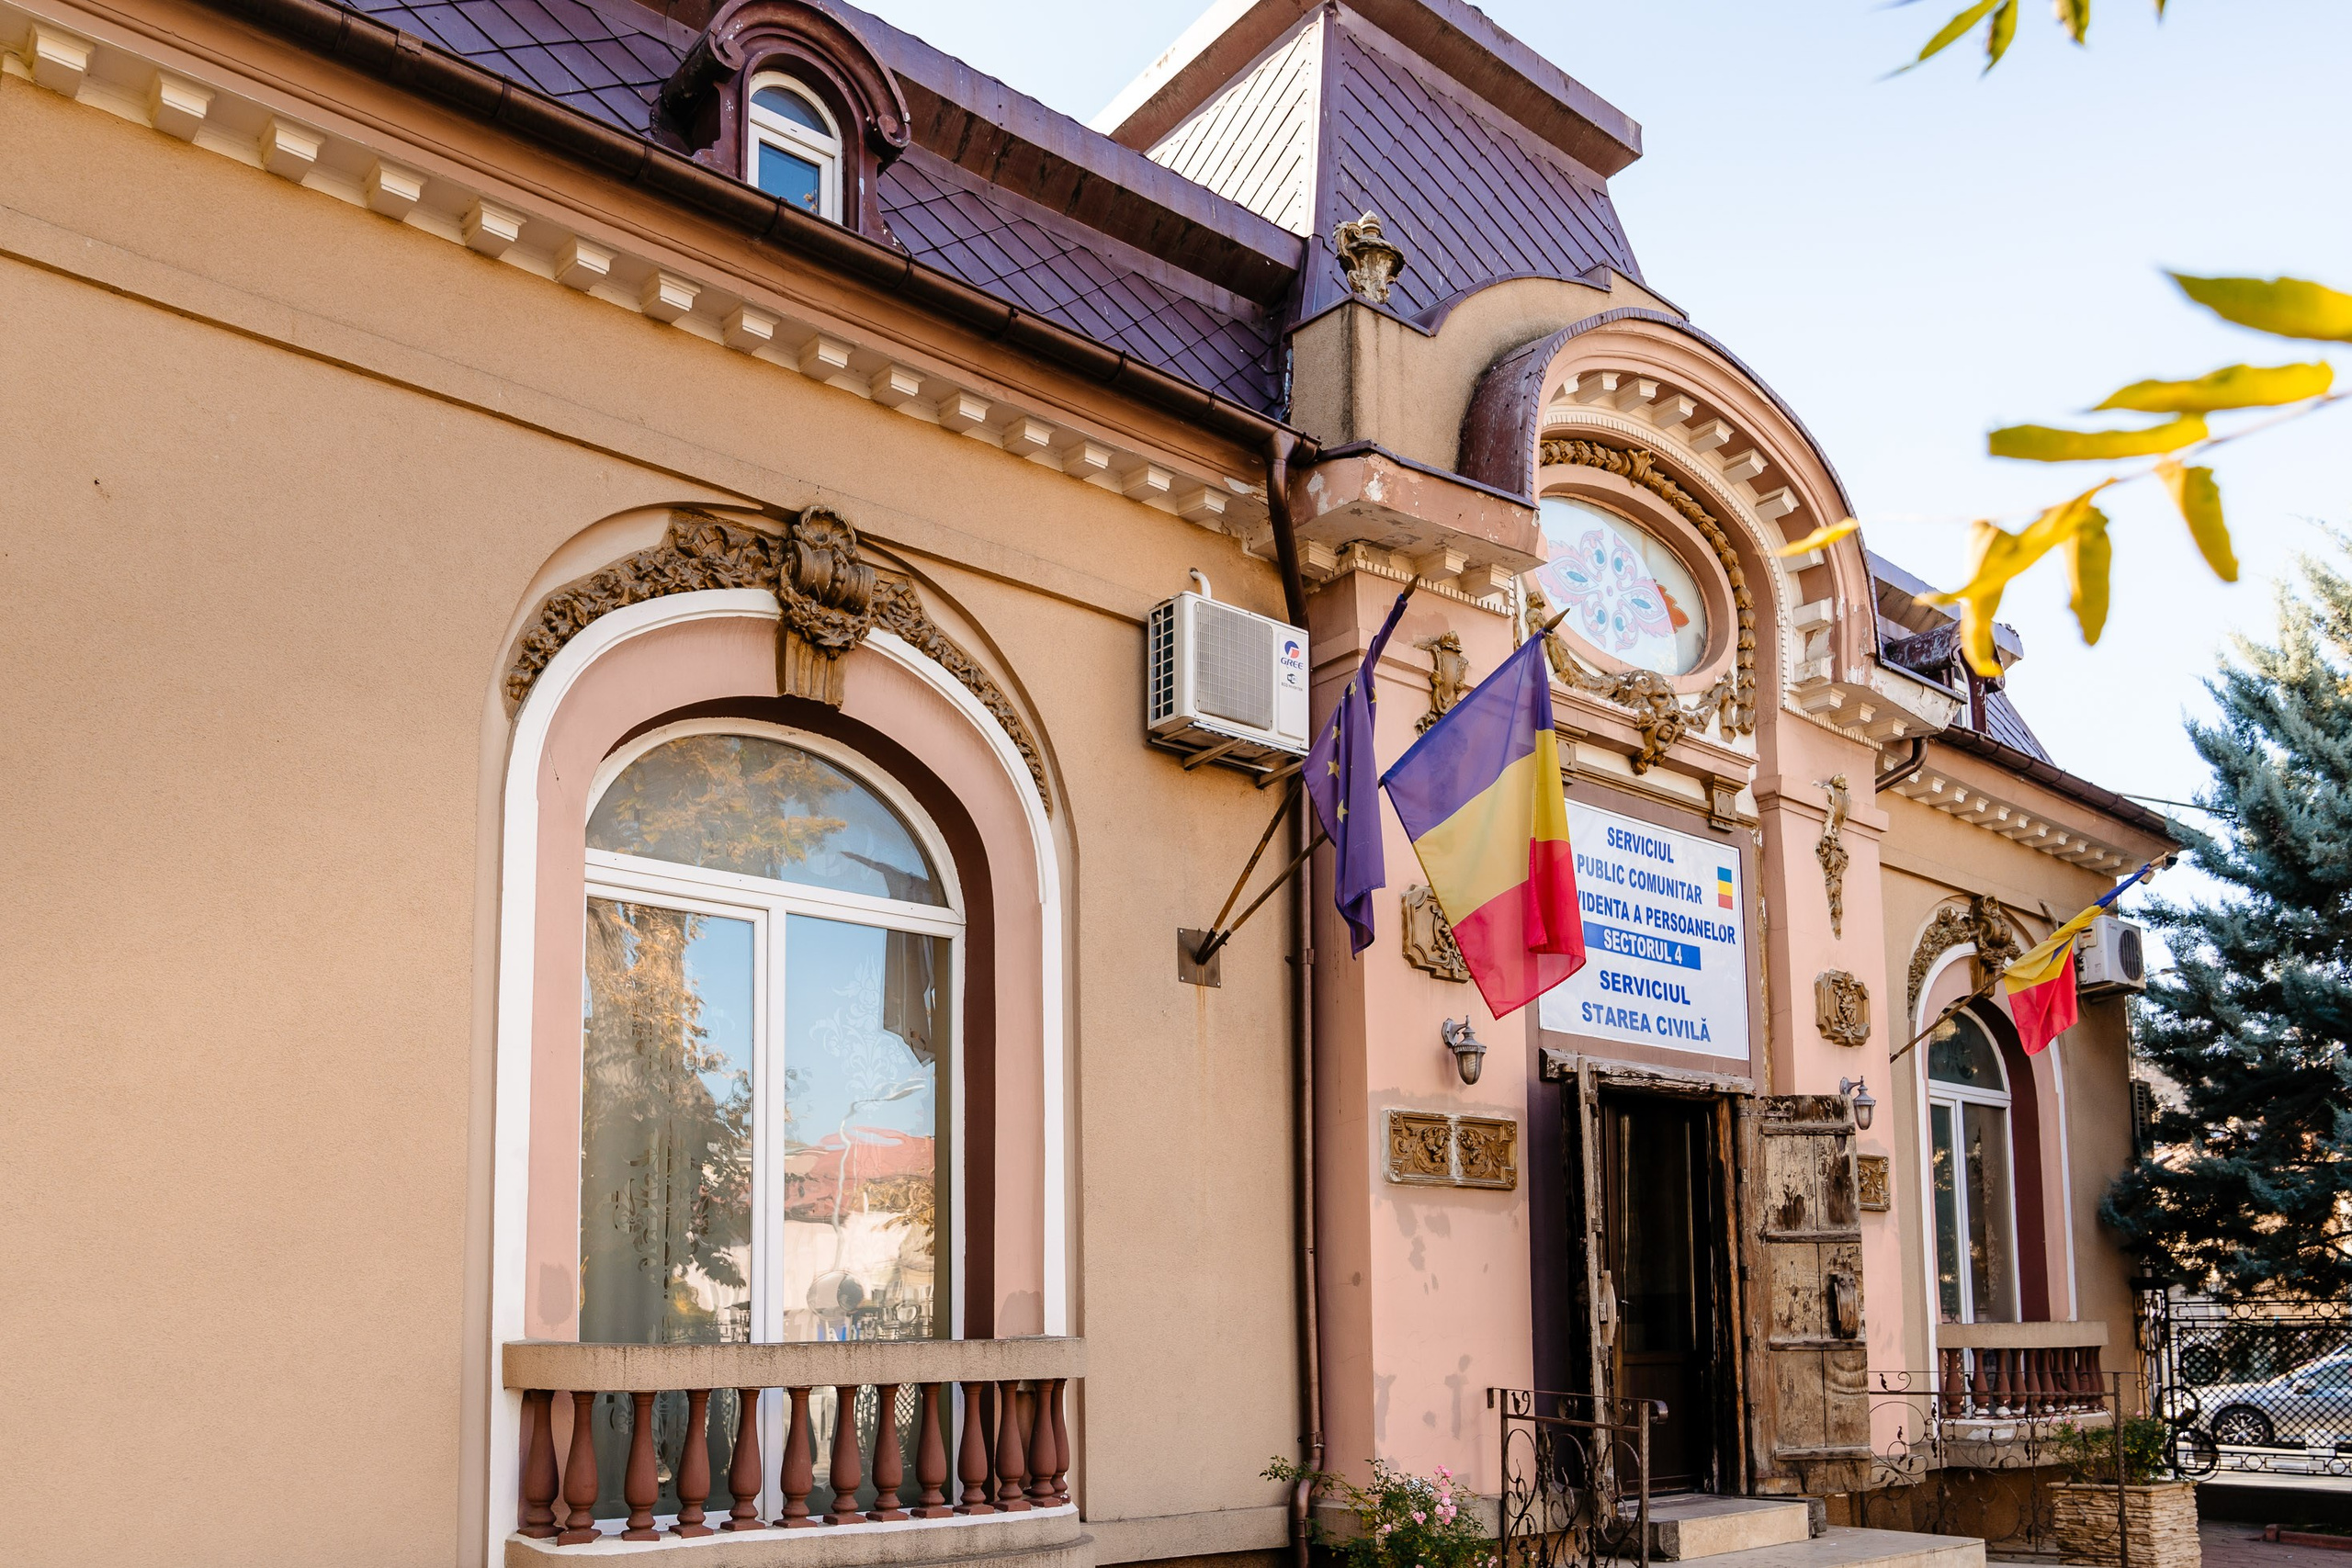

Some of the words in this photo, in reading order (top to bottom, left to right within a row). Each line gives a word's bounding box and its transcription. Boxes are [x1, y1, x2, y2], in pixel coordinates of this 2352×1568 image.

[1280, 657, 1304, 670] GREE
[1607, 827, 1674, 863] SERVICIUL
[1577, 853, 1624, 885] PUBLIC
[1629, 868, 1702, 905] COMUNITAR
[1634, 904, 1642, 925] A
[1645, 907, 1736, 944] PERSOANELOR
[1603, 929, 1672, 963] SECTORUL
[1674, 944, 1683, 964] 4
[1600, 970, 1690, 1005] SERVICIUL
[1582, 1002, 1652, 1033] STAREA
[1657, 1015, 1711, 1043] CIVILĂ
